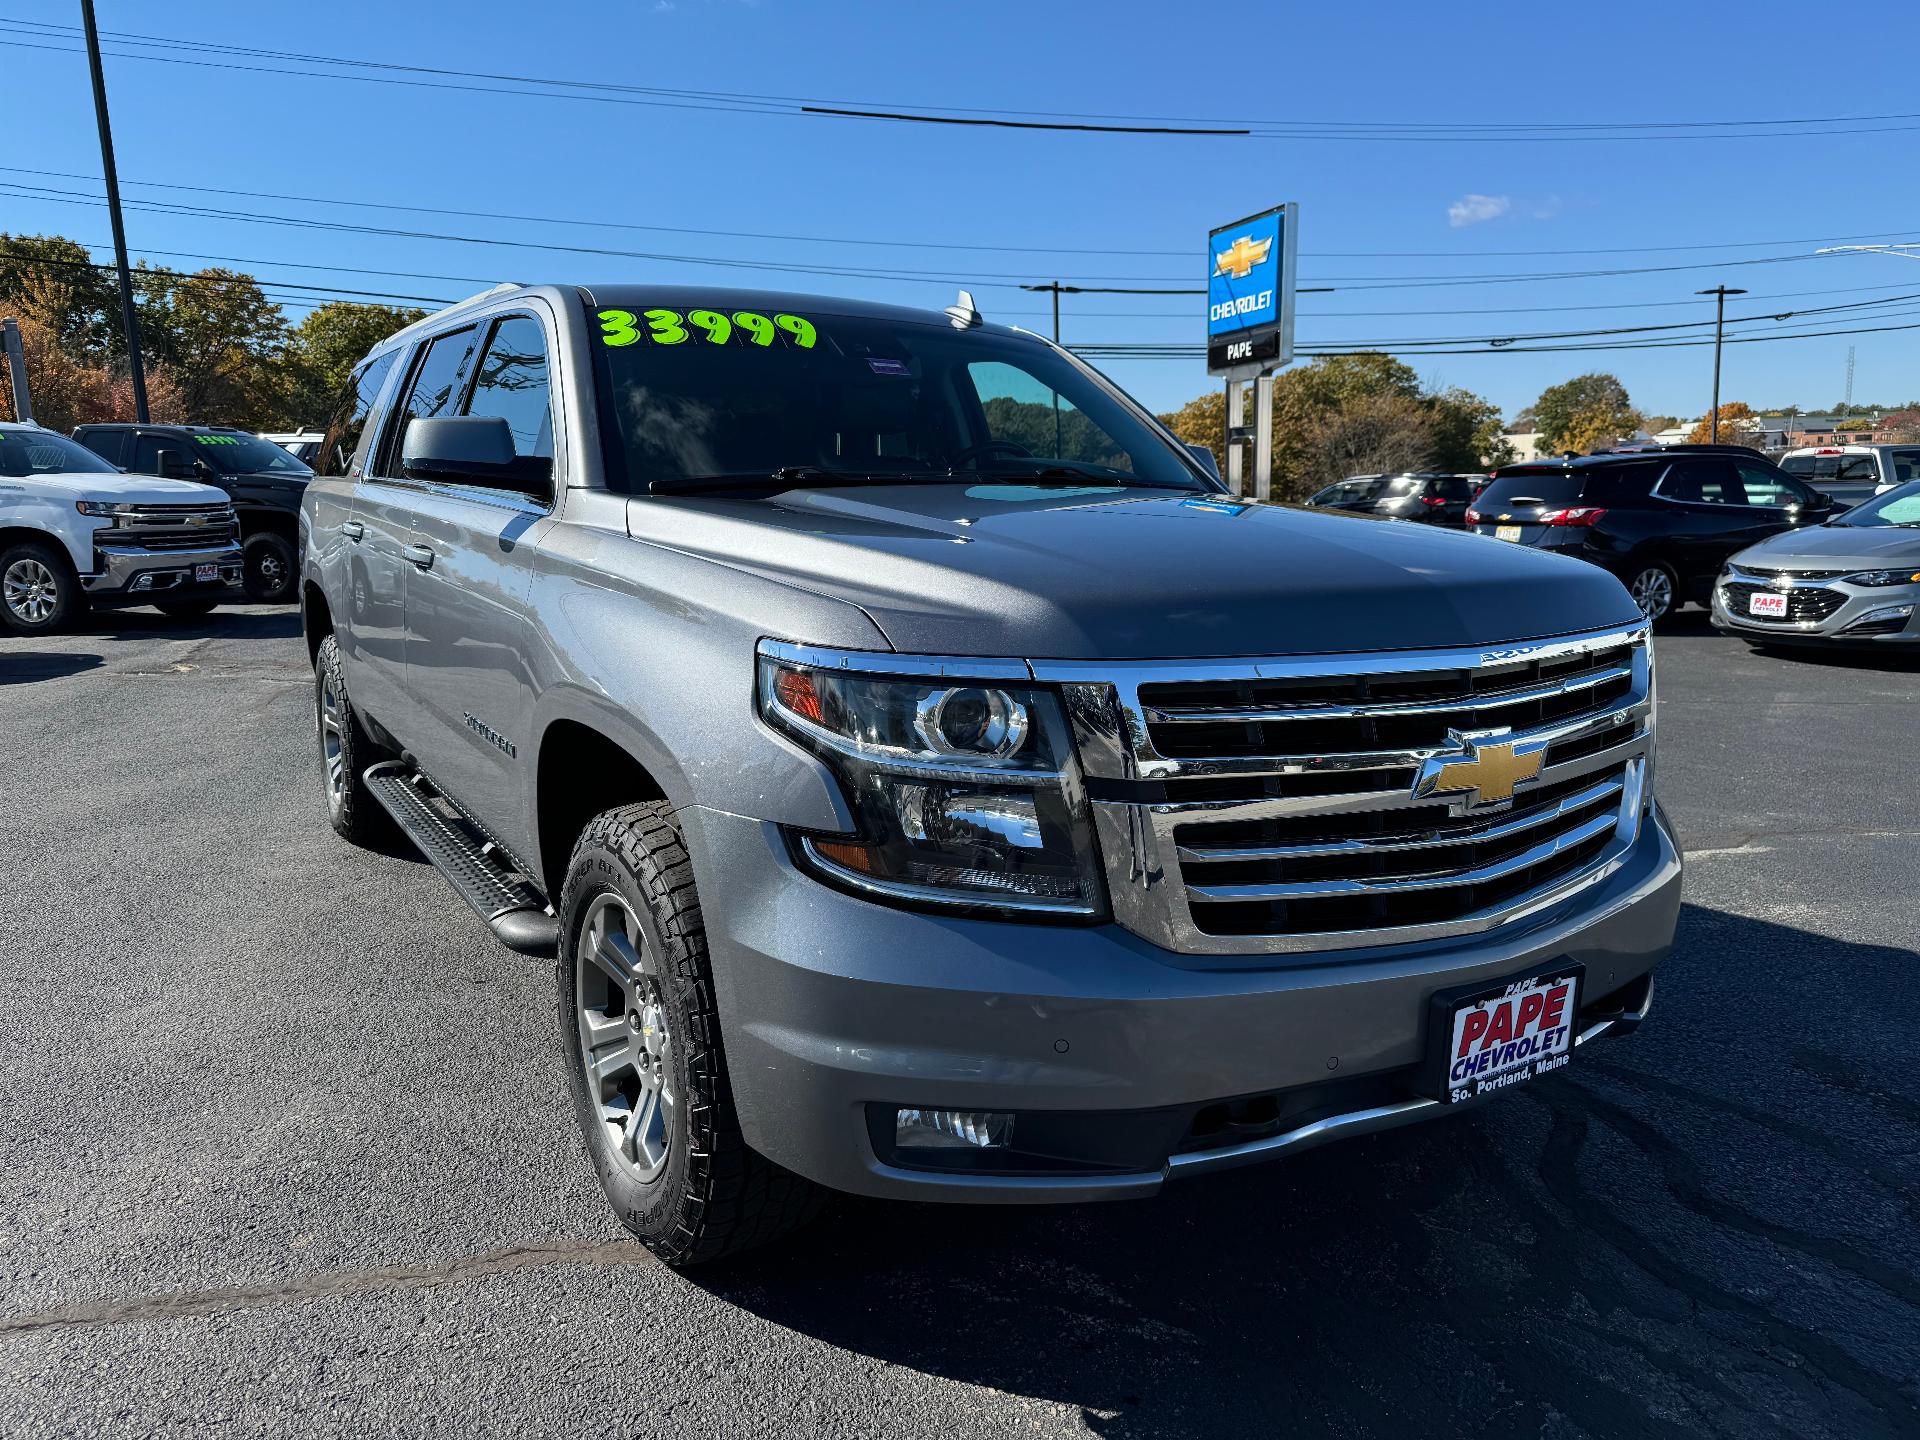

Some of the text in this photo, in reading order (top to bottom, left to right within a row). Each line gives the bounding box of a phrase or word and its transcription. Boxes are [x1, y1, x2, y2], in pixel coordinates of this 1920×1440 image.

[1210, 290, 1272, 322] CHEVROLET
[597, 309, 817, 349] 33999
[1227, 341, 1253, 360] PAPE
[197, 565, 217, 574] PAPE
[1754, 598, 1783, 607] PAPE
[1505, 977, 1539, 997] PAPE
[1457, 983, 1569, 1059] PAPE
[1450, 1025, 1568, 1082] CHEVROLET
[1451, 1053, 1570, 1104] So. Portland, Maine
